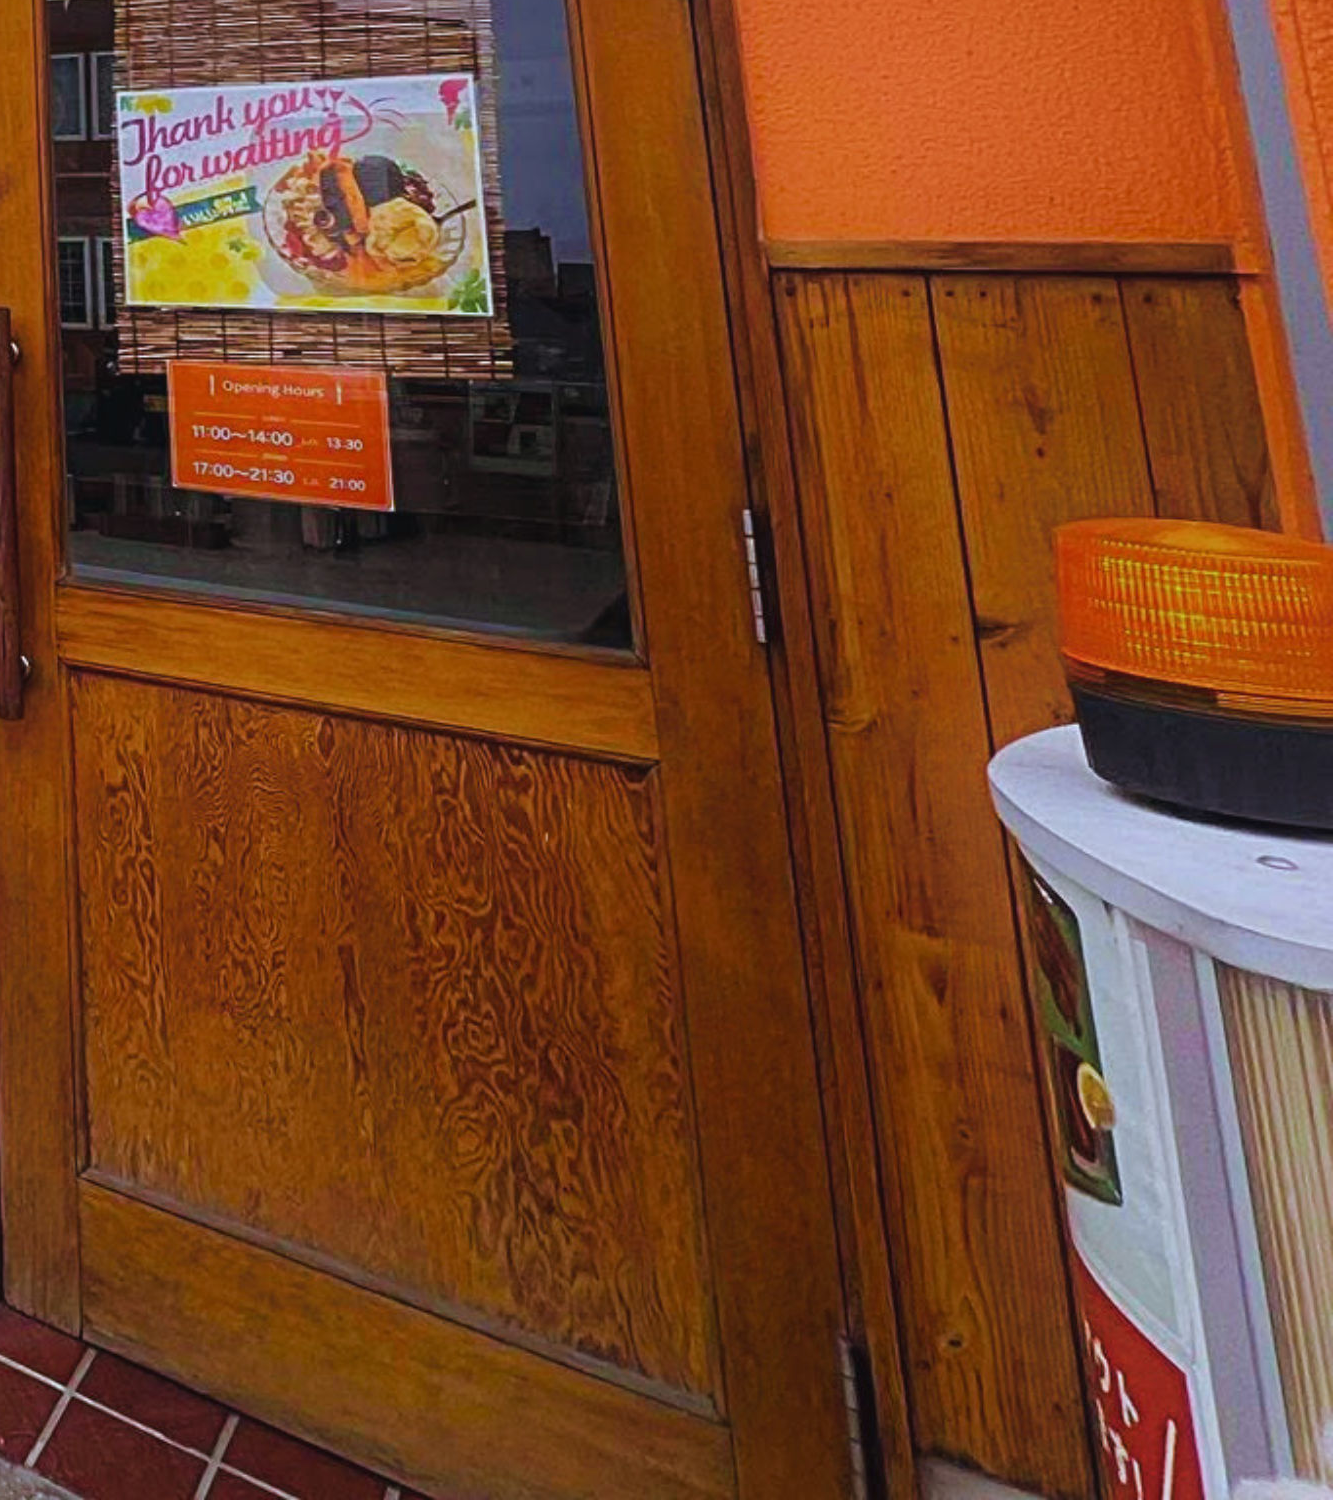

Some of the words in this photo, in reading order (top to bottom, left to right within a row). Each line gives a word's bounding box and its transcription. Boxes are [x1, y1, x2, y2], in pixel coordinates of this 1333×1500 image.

[121, 95, 236, 167] Thank
[242, 86, 314, 139] you
[145, 153, 197, 208] for
[199, 112, 347, 181] waiting
[222, 380, 280, 397] Opening
[282, 384, 326, 399] Hours
